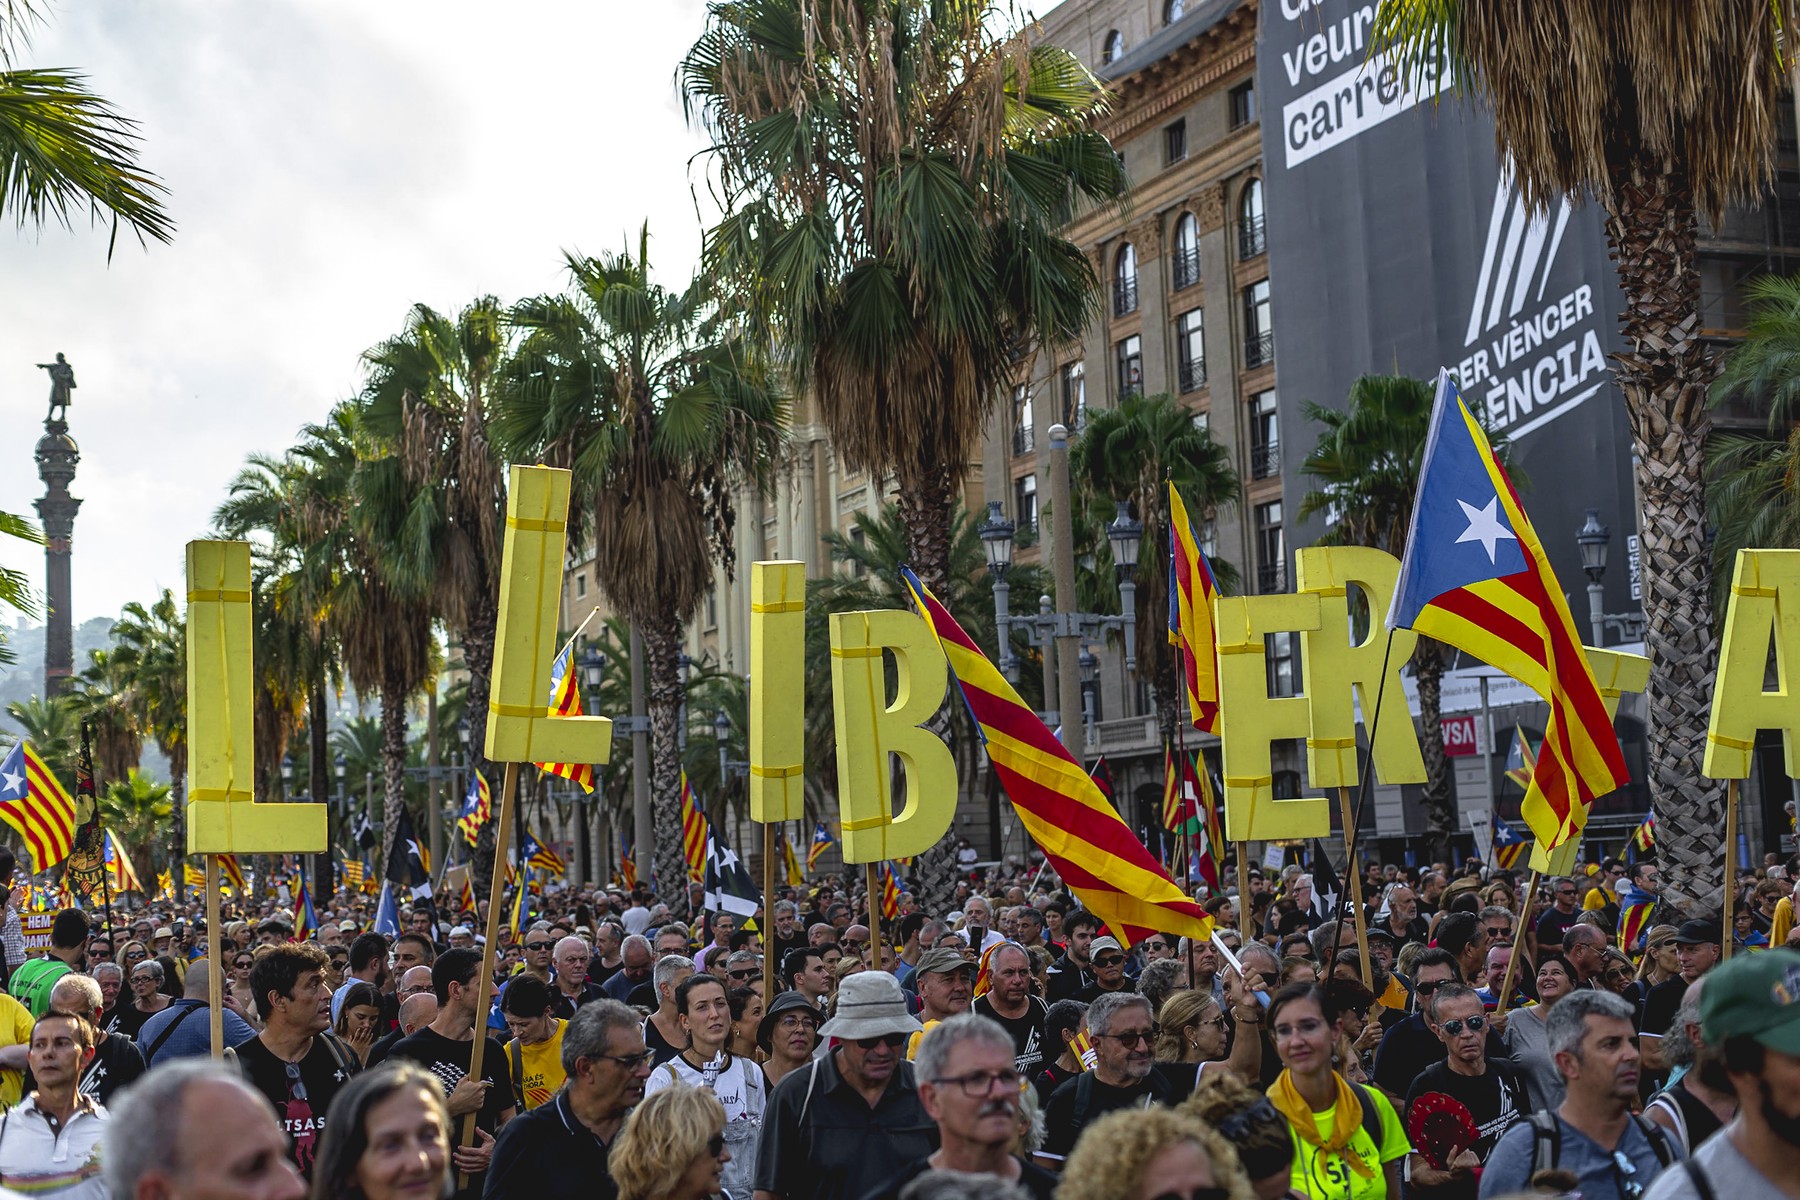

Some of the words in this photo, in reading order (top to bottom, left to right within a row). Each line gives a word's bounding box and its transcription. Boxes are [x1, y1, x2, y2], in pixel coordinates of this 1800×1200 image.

[1491, 284, 1594, 370] VÈNCER
[1480, 329, 1607, 432] ÈNCIA
[23, 933, 52, 948] UANY
[28, 914, 51, 929] HEM
